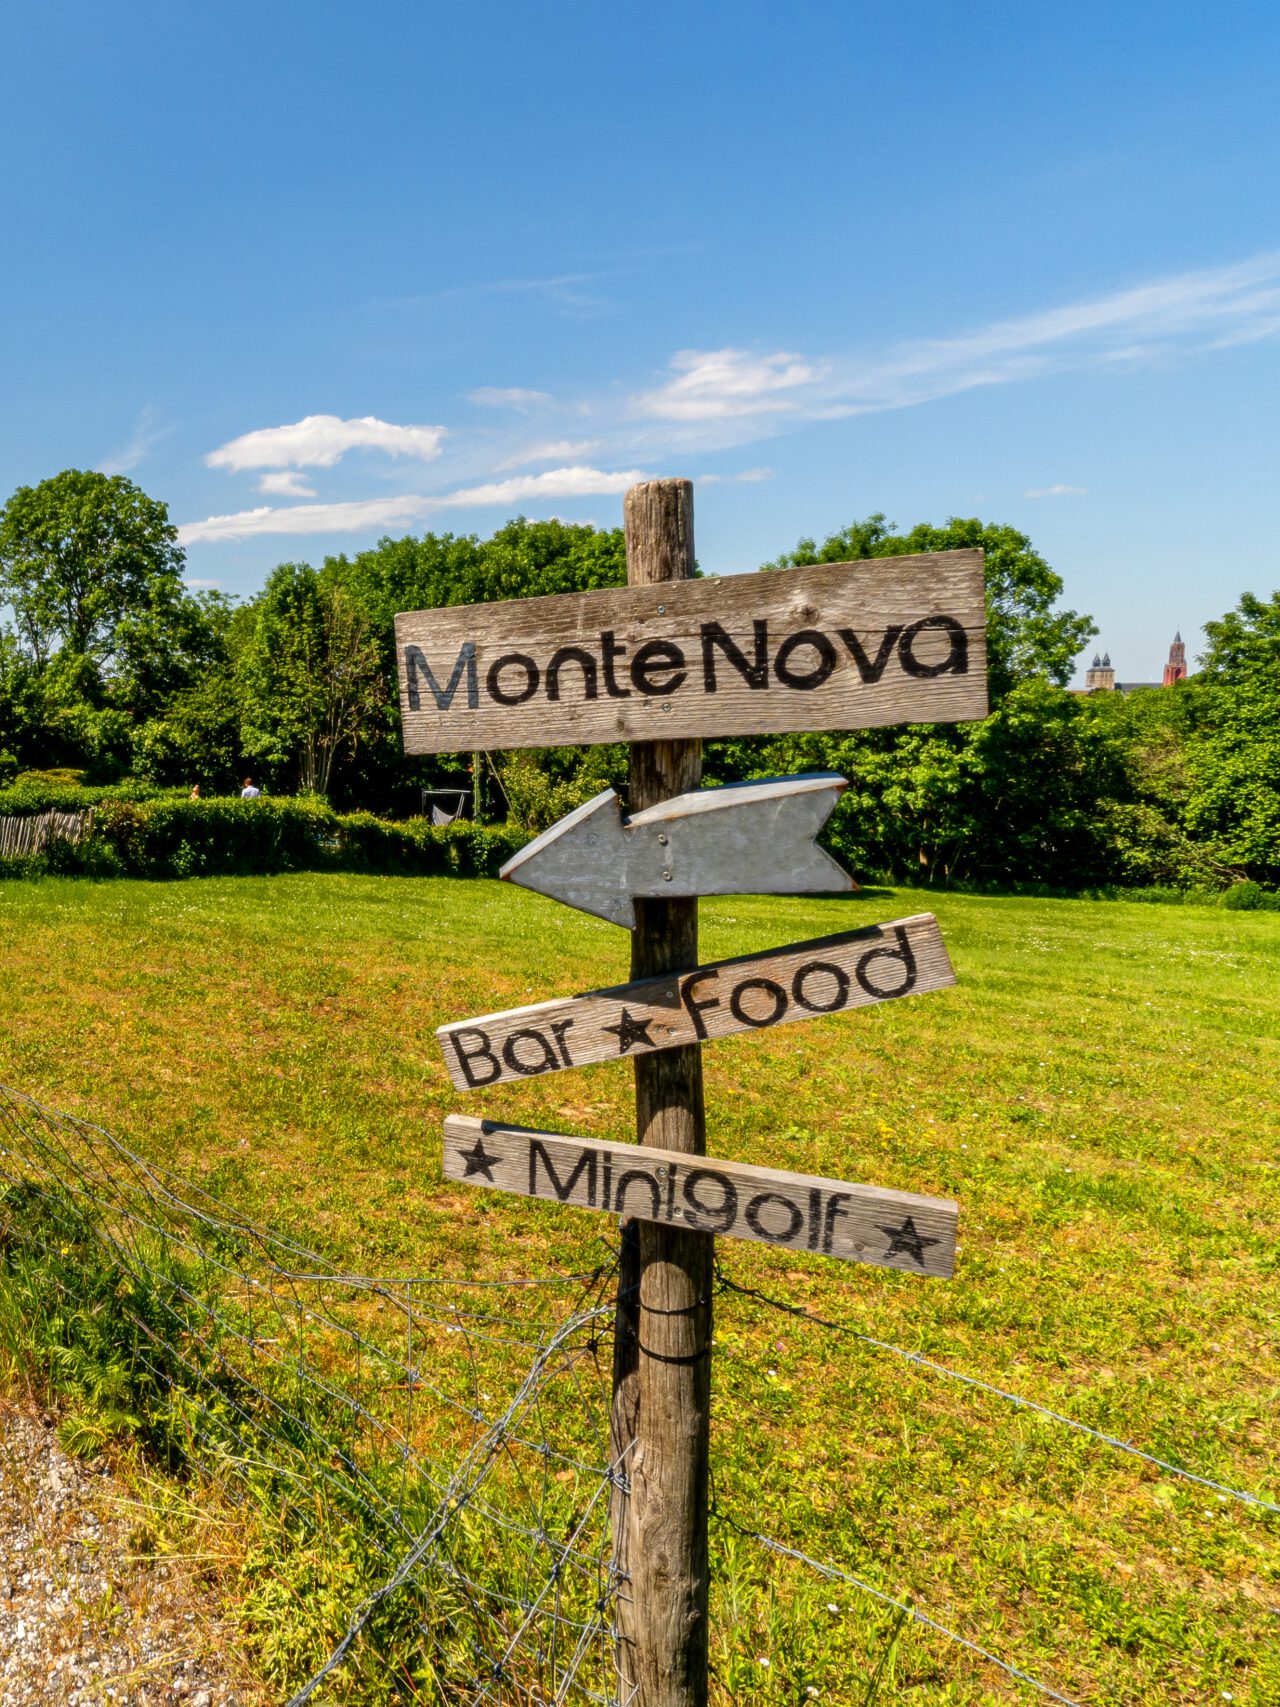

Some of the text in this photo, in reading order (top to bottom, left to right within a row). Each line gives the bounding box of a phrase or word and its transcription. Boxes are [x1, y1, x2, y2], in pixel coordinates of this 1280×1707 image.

[448, 925, 918, 1088] Bar Food
[528, 1137, 852, 1254] Minigolf
